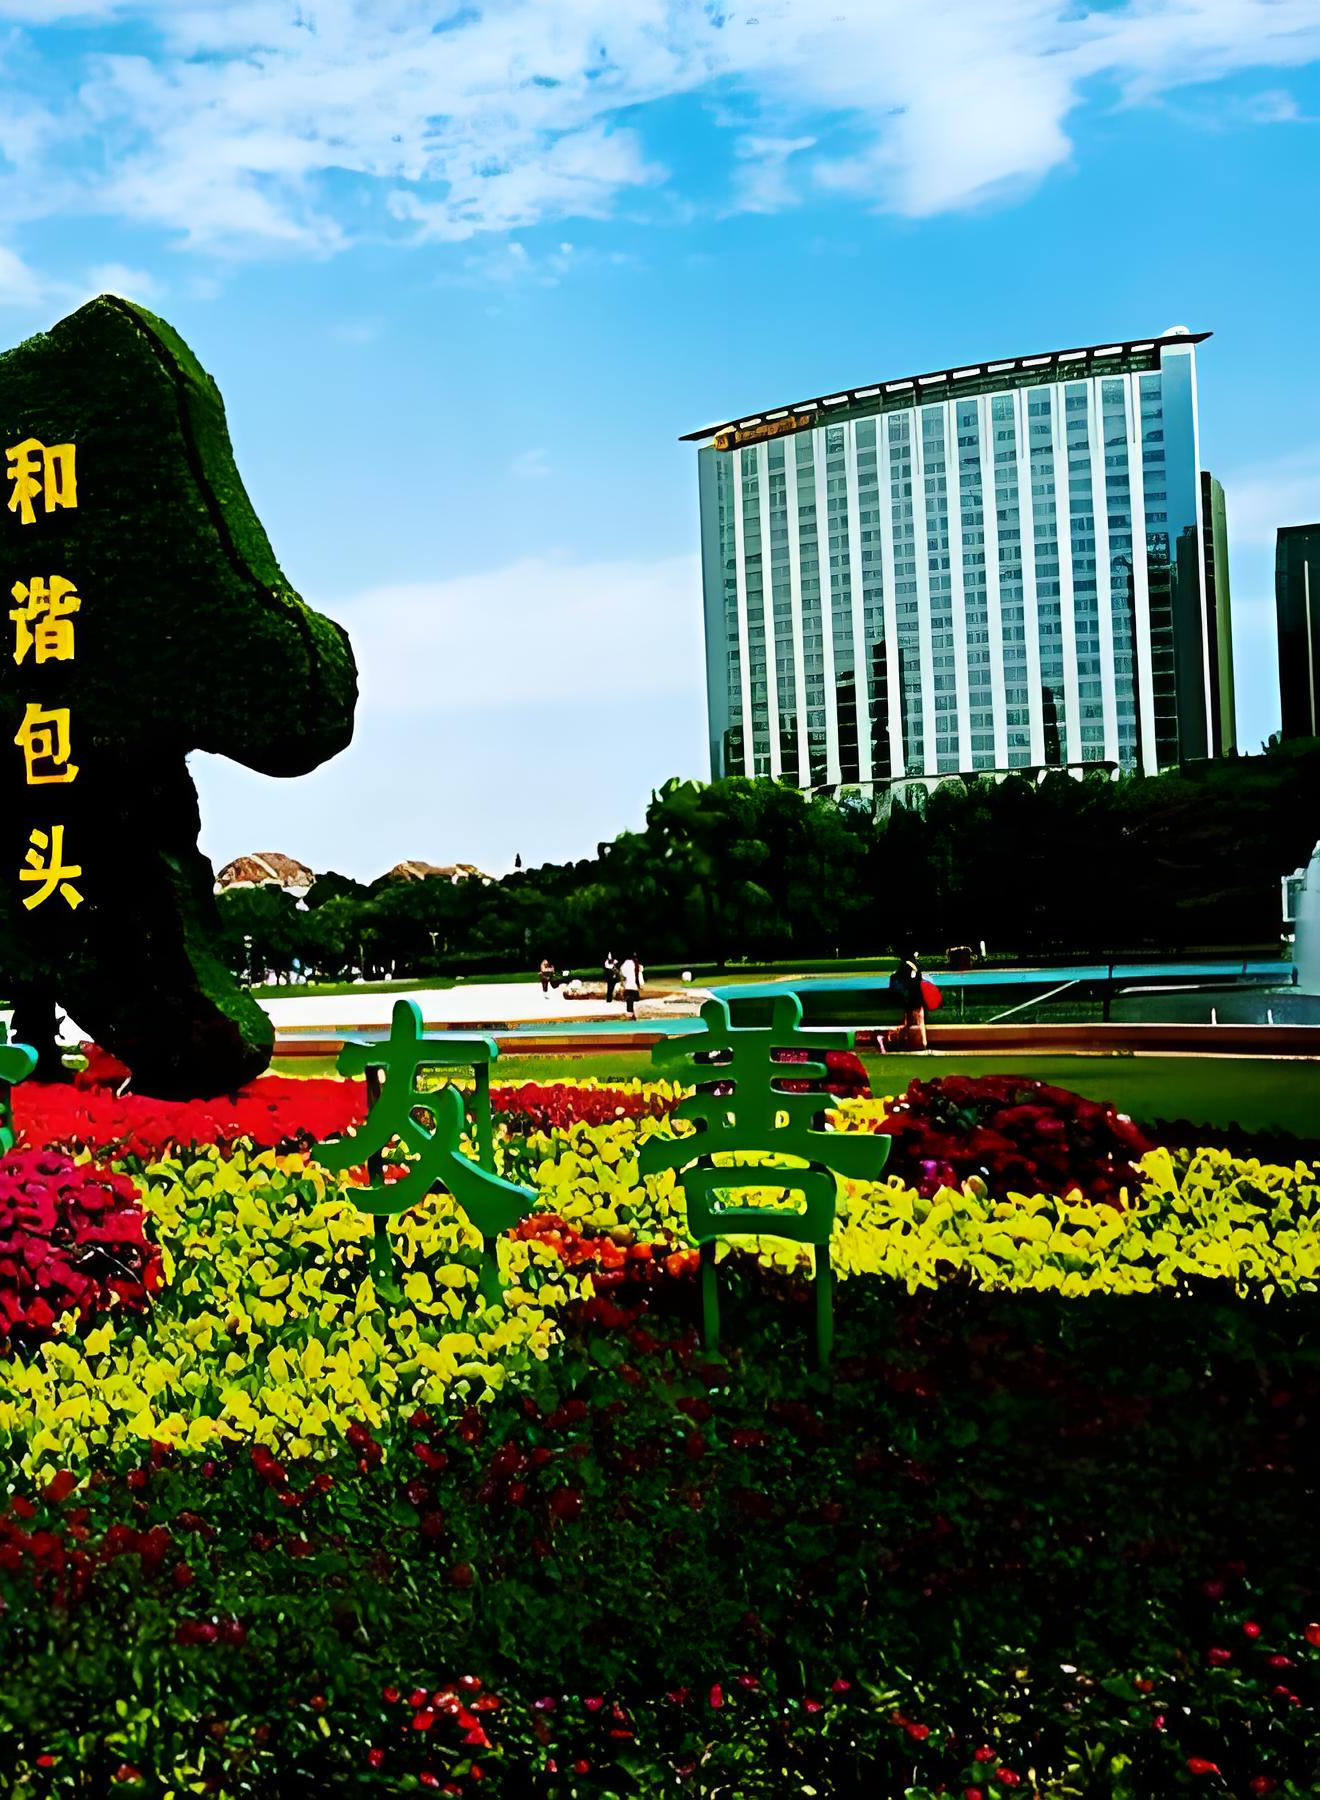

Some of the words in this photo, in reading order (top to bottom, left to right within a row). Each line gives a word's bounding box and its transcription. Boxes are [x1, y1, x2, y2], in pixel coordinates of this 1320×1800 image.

[6, 437, 84, 911] 和谐包头
[312, 991, 891, 1246] 友善
